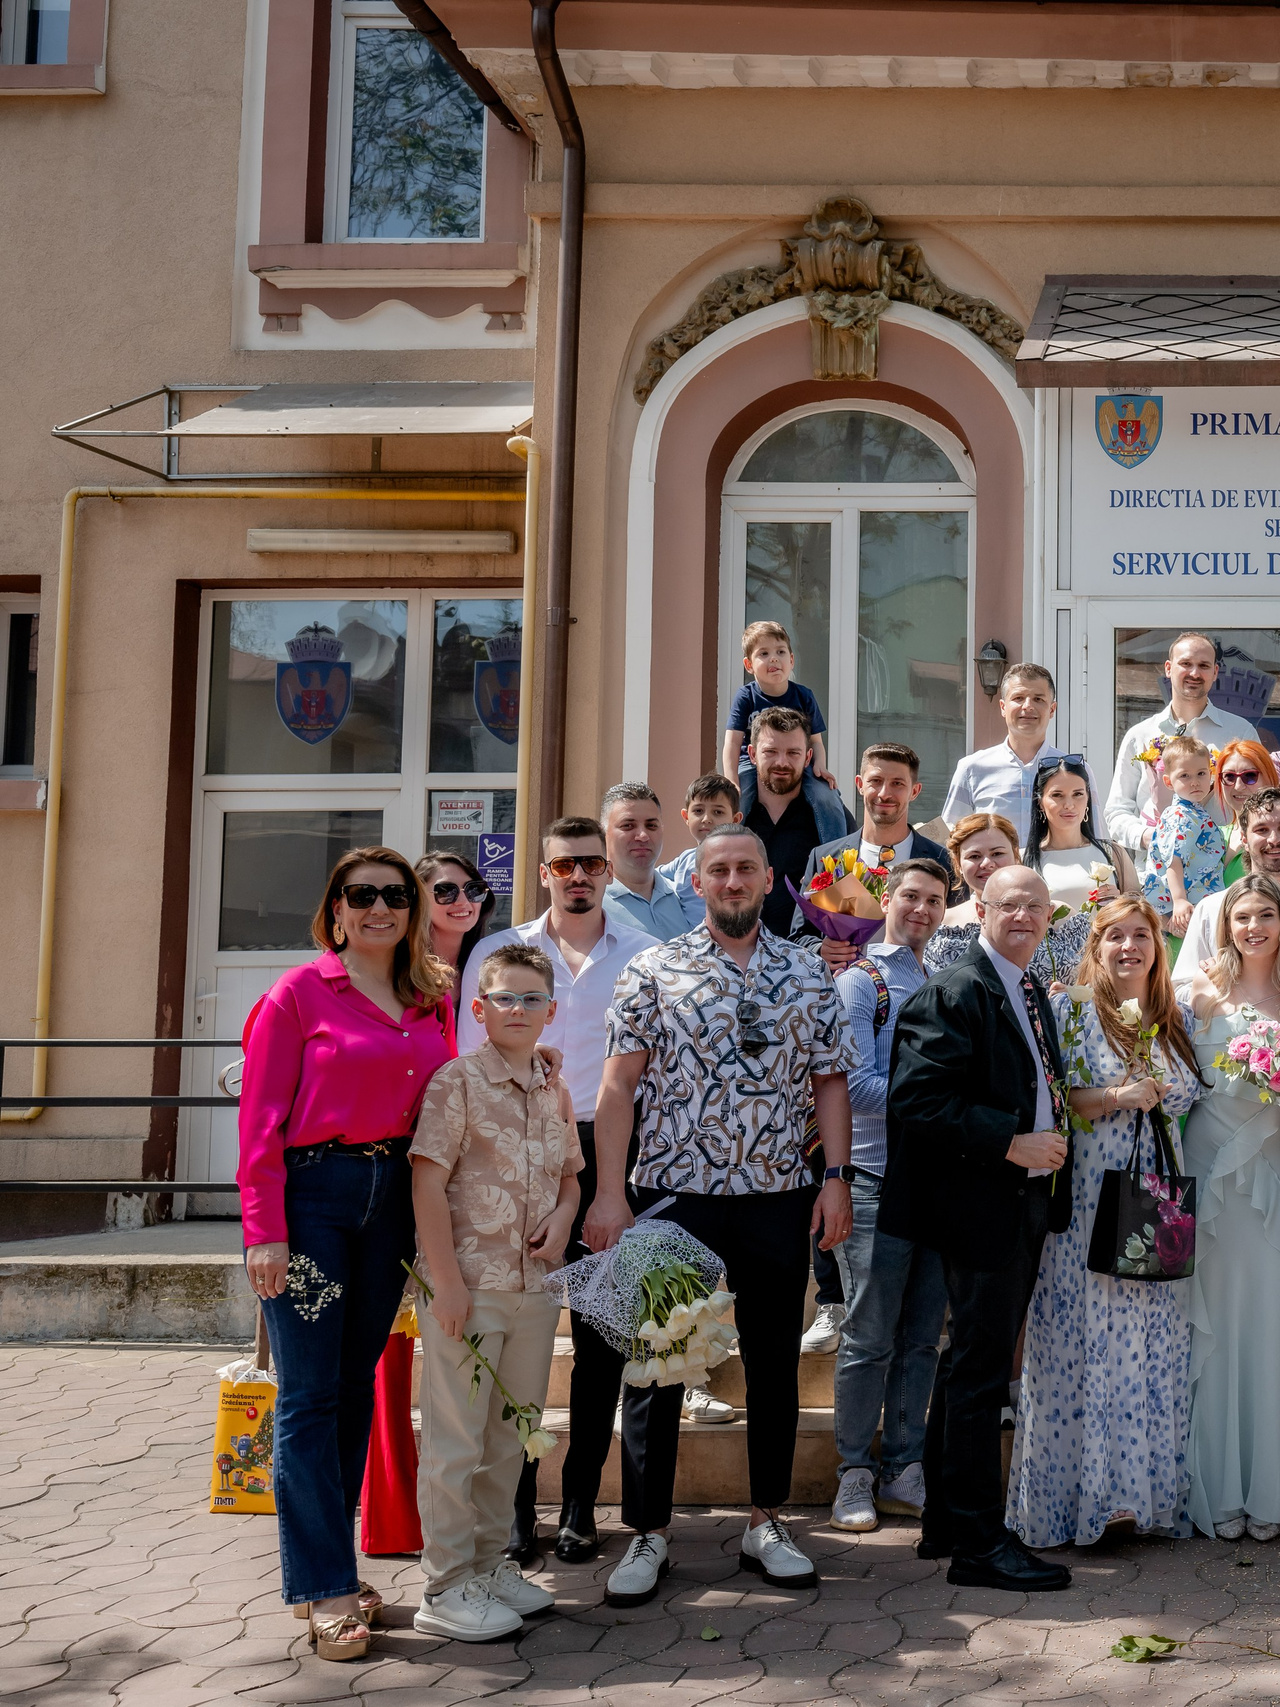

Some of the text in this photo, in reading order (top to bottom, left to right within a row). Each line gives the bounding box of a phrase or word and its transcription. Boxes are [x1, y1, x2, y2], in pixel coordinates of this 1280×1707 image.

[1109, 489, 1206, 508] DIRECTIA
[1211, 489, 1239, 508] DE
[1112, 552, 1259, 576] SERVICIUL
